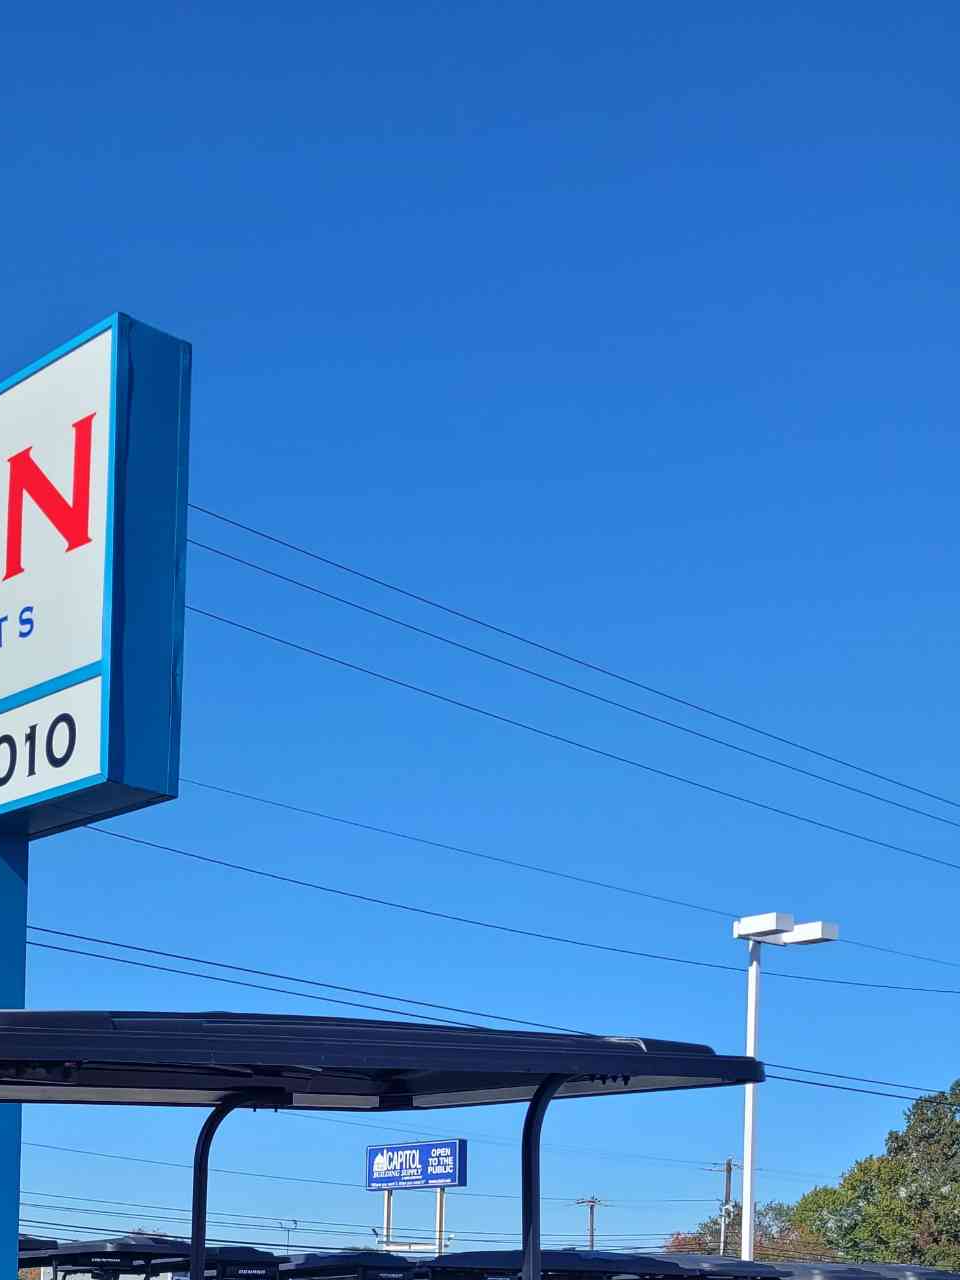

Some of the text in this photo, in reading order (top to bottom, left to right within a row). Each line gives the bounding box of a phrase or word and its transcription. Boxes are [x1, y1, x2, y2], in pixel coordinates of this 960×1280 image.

[431, 1147, 451, 1157] OPEN
[386, 1149, 422, 1170] CAPITOL
[428, 1156, 453, 1166] TO THE
[427, 1165, 453, 1174] PUBLIC
